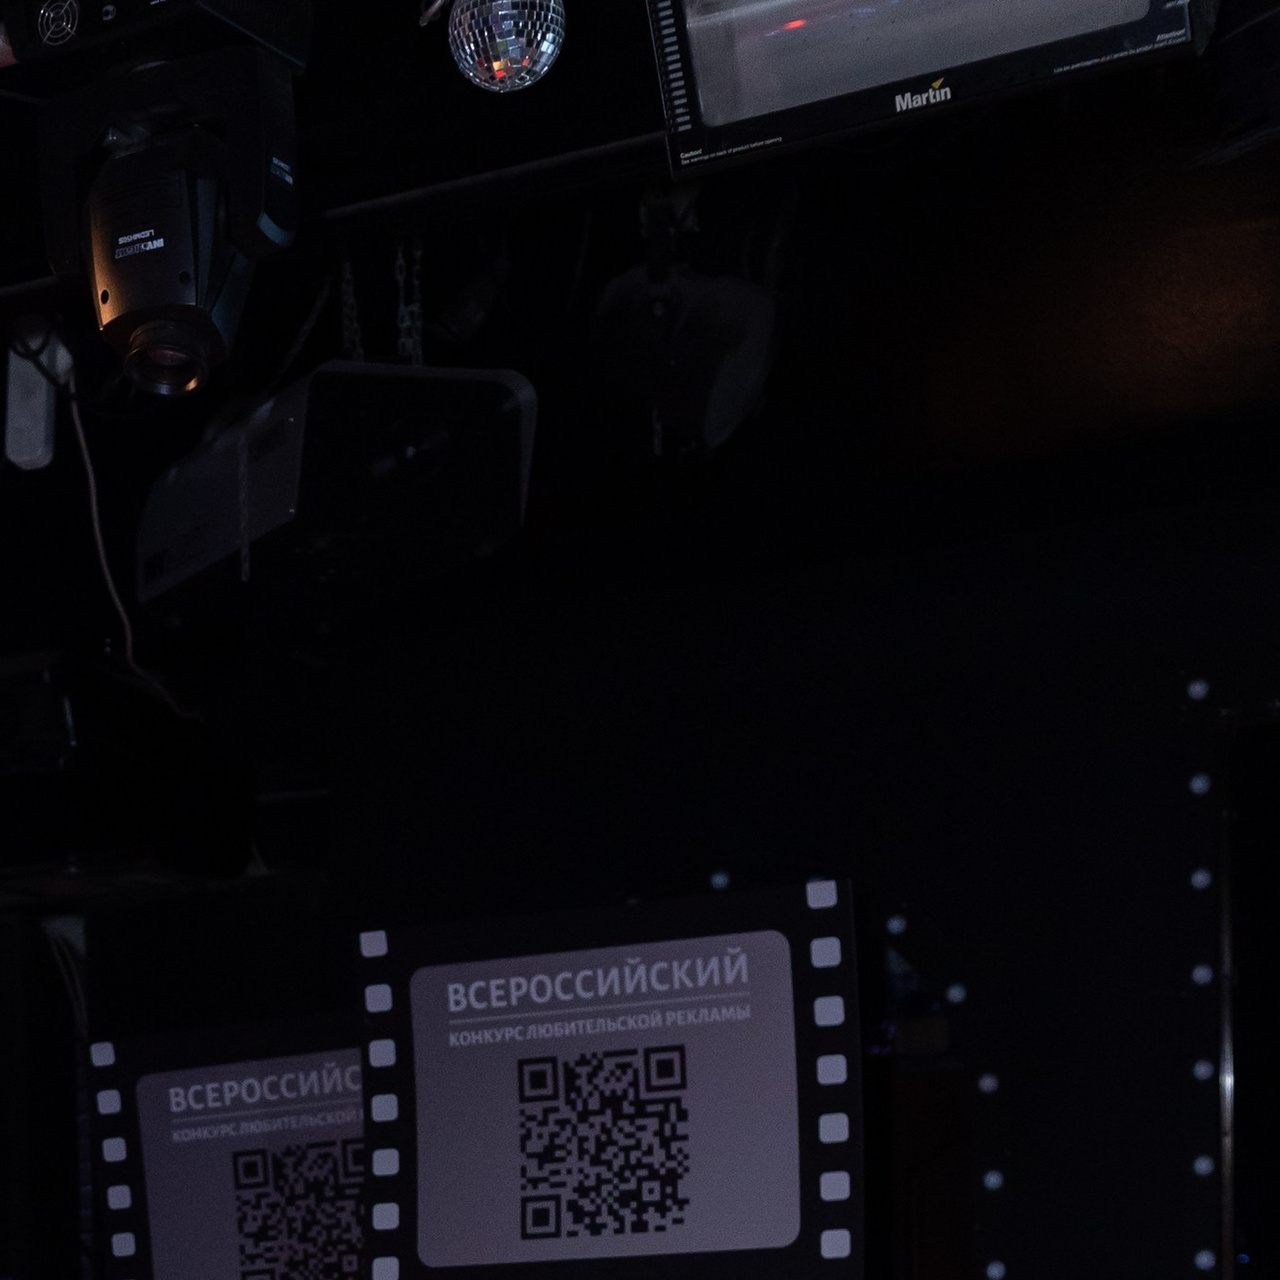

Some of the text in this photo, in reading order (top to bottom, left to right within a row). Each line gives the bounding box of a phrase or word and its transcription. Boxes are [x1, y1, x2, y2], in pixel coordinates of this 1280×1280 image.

[895, 80, 952, 112] Martin
[447, 947, 749, 1012] ВСЕРОССИЙСКИЙ
[449, 1005, 752, 1048] КОНКУРС ЛЮБИТЕЛЬСКОЙ РЕКЛАМЫ
[172, 1123, 238, 1143] КОНКУРС
